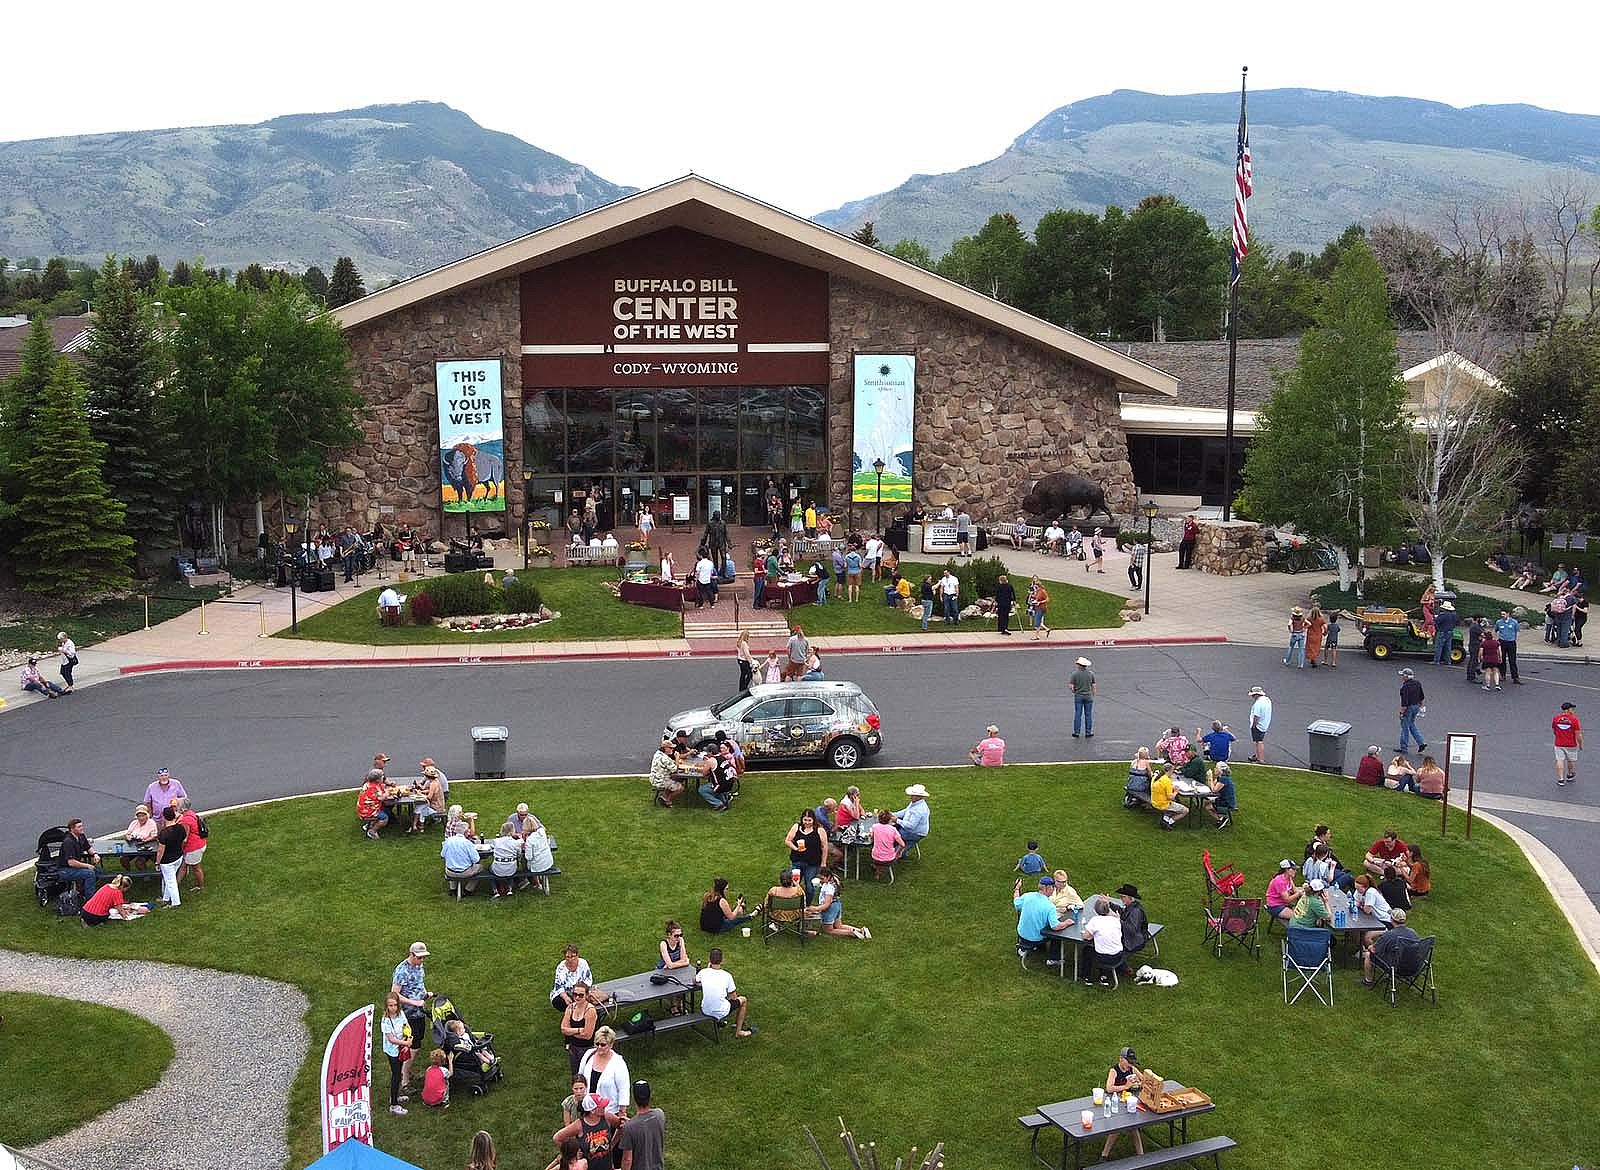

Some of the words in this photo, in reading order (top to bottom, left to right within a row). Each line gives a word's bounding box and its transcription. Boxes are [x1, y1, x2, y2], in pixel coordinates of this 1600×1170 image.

[614, 280, 696, 292] BUFFALO
[700, 280, 738, 292] BILL
[613, 297, 738, 320] CENTER
[613, 324, 640, 339] OF
[643, 325, 681, 339] THE
[684, 324, 738, 339] WEST
[451, 370, 486, 383] THIS
[462, 384, 477, 397] IS
[448, 398, 492, 411] YOUR
[448, 412, 492, 425] WEST
